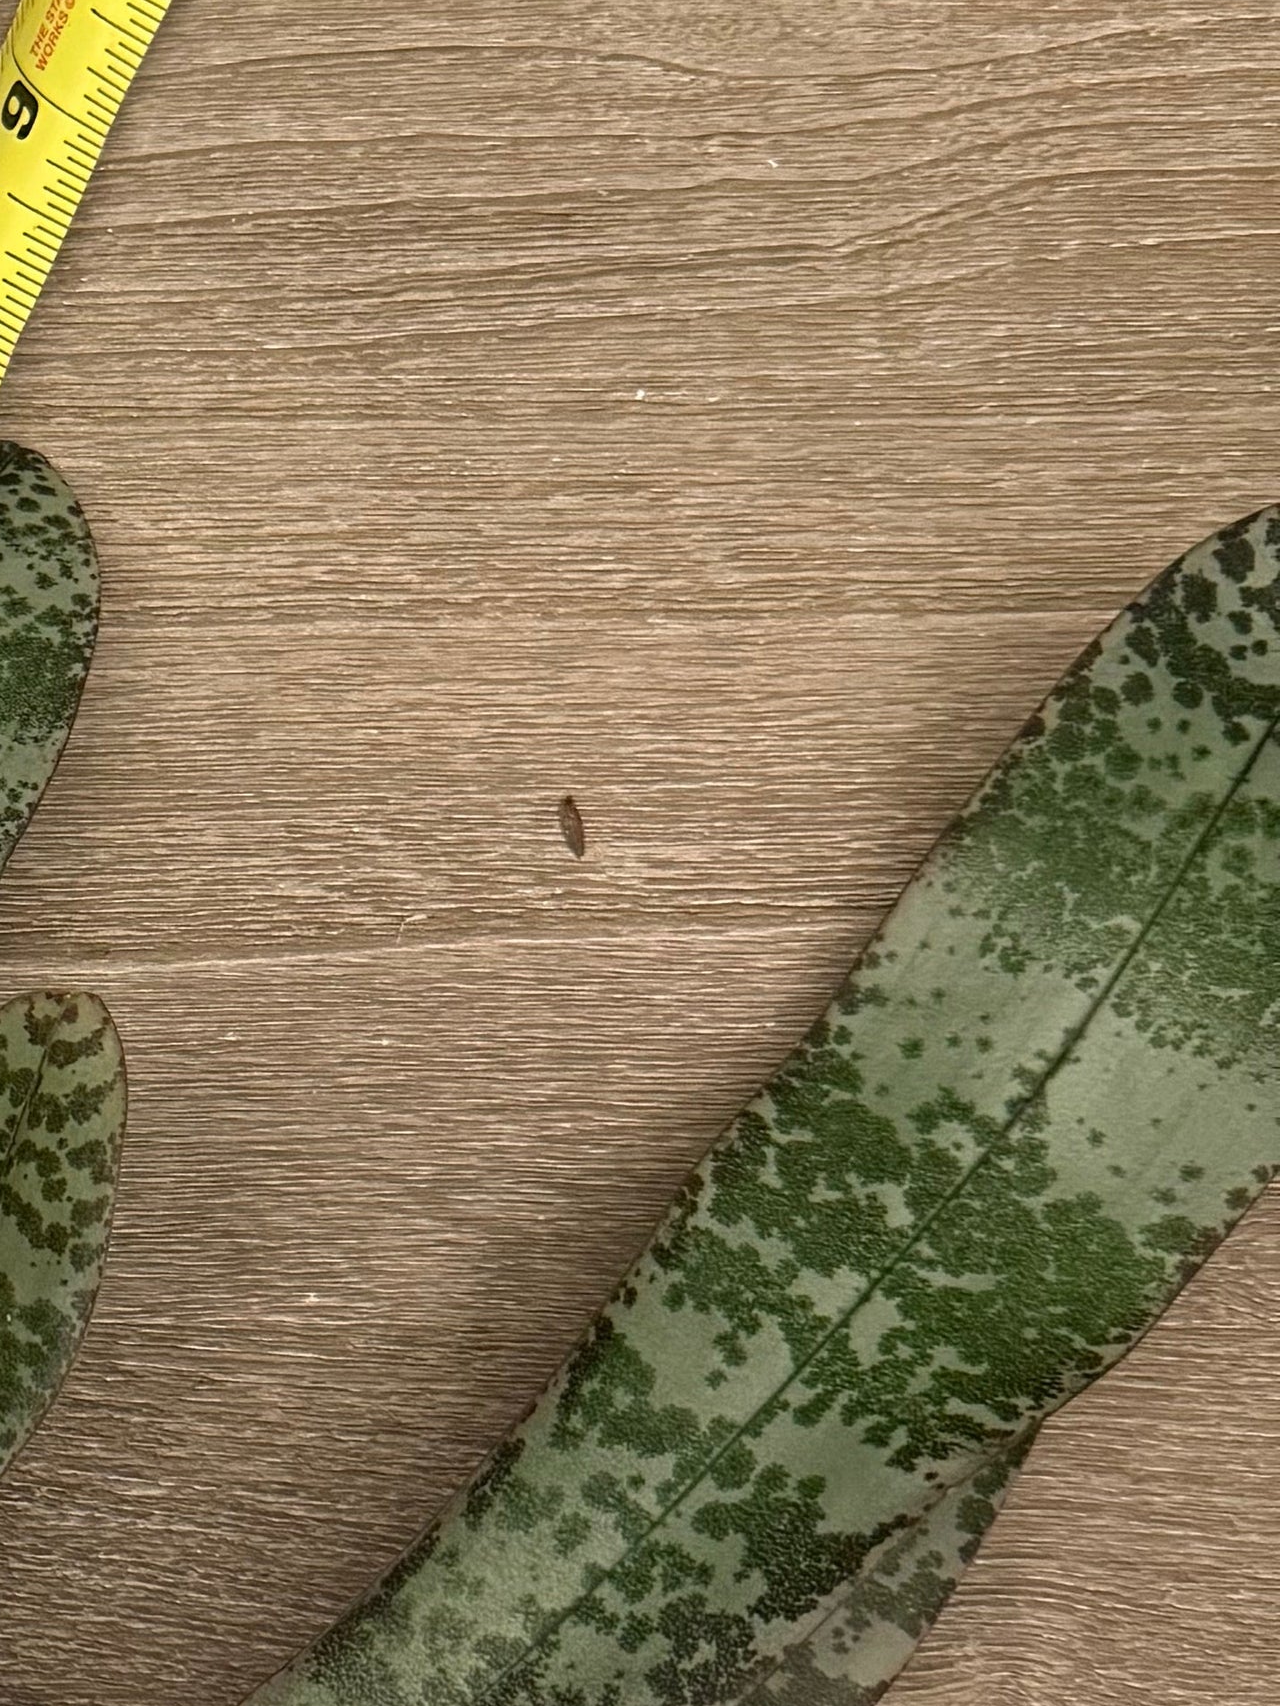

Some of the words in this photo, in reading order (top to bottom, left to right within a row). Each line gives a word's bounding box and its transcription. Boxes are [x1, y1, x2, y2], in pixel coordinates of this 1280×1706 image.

[29, 22, 49, 57] THE
[35, 10, 69, 71] WORKS
[0, 80, 40, 140] 9
